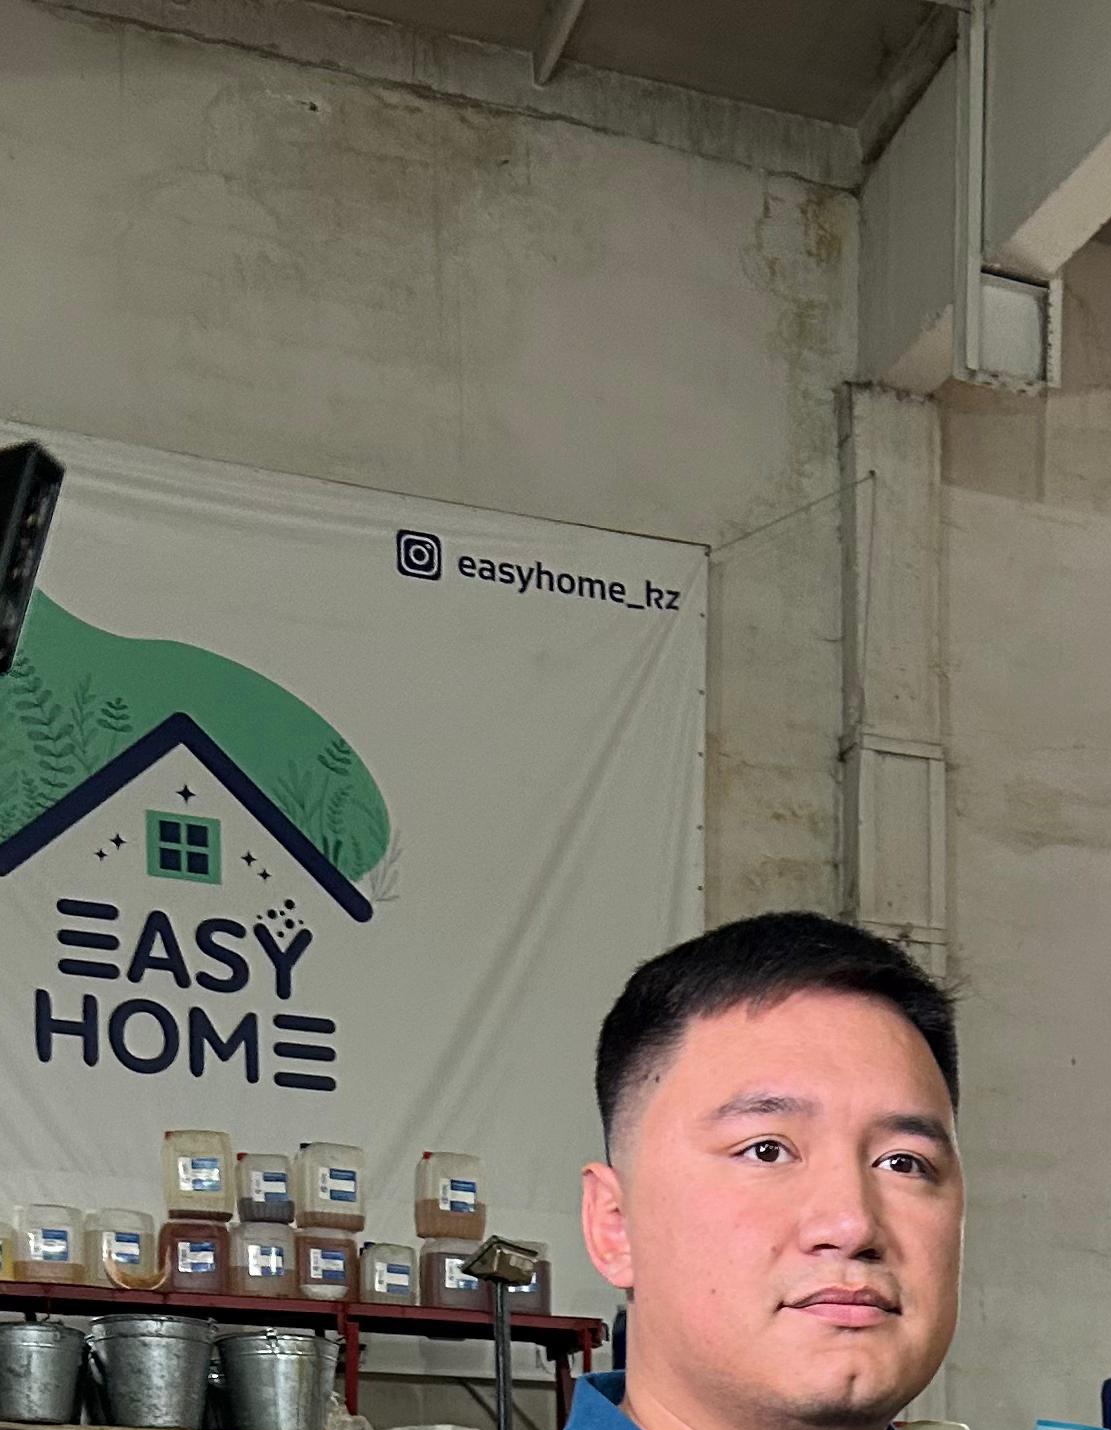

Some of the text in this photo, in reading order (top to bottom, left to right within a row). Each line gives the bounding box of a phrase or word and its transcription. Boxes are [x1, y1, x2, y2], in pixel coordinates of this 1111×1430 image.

[457, 554, 681, 611] easyhome_kz
[56, 898, 313, 1000] EASY
[35, 988, 337, 1092] HOME
